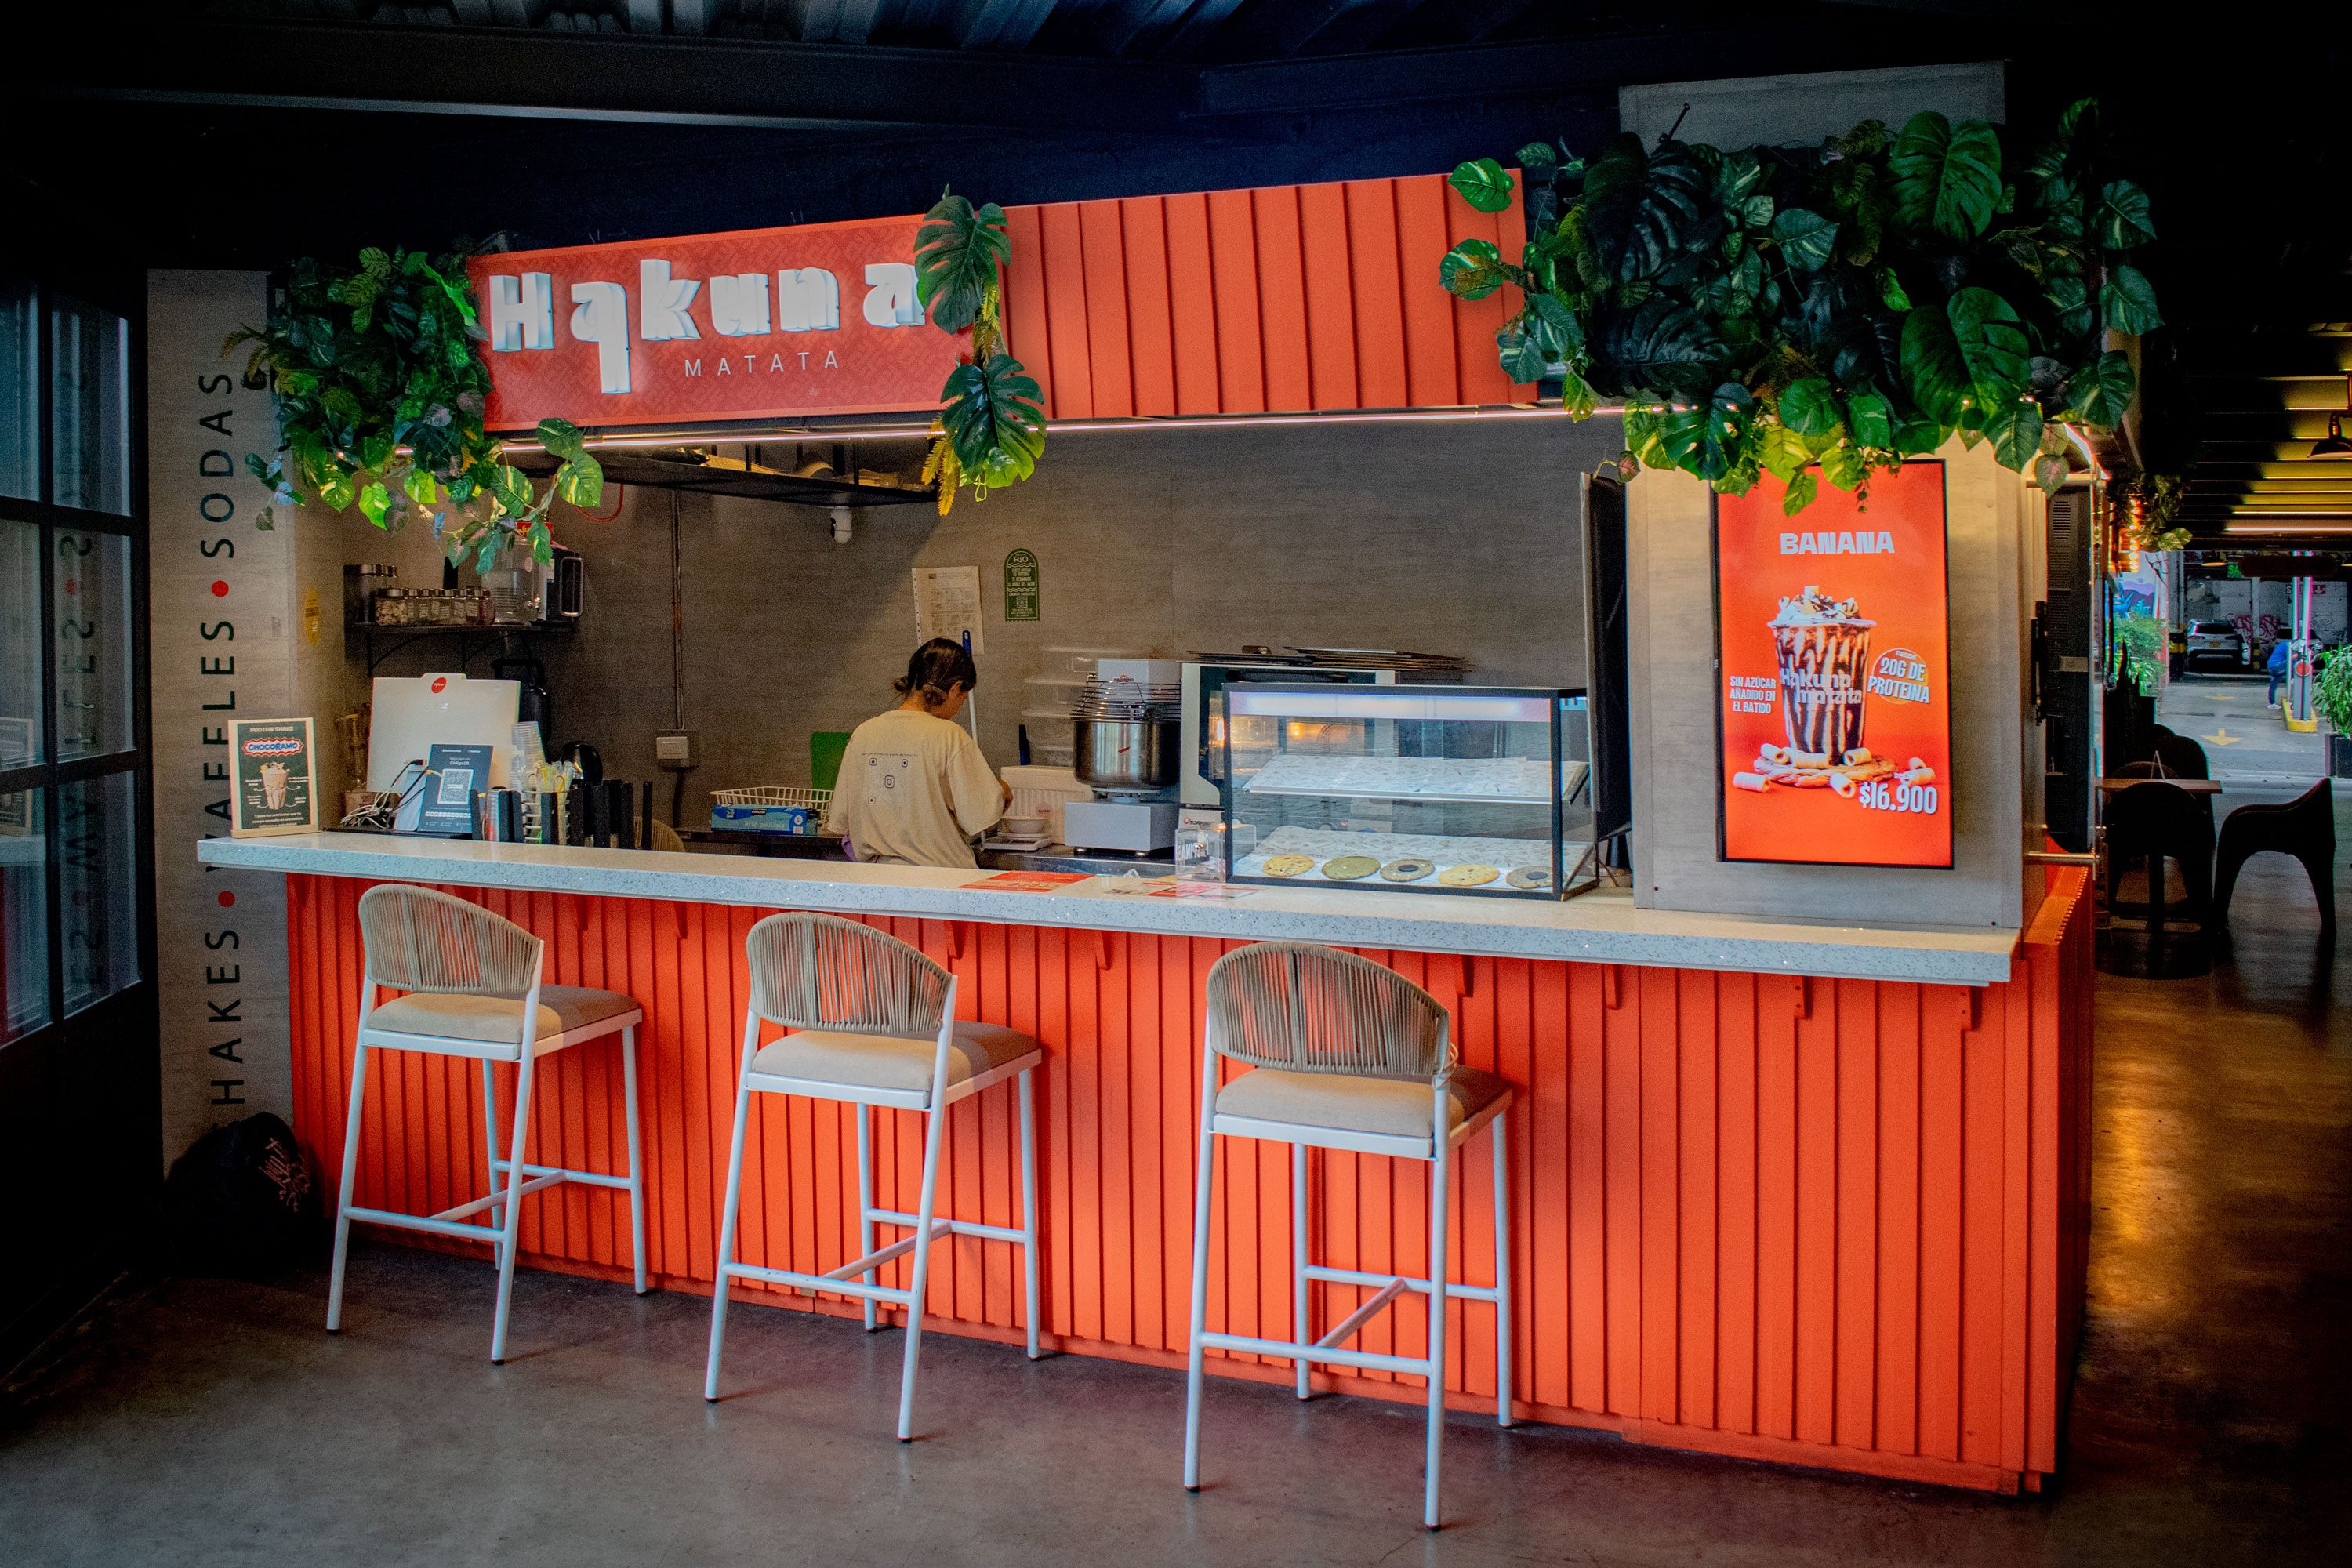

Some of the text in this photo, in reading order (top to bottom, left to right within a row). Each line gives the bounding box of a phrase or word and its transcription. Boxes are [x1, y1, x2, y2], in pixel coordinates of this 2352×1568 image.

[489, 259, 925, 394] Hakuna
[684, 350, 839, 377] MATATA
[198, 375, 234, 558] SODAS
[1780, 532, 1895, 555] BANANA
[1780, 667, 1852, 690] Hakuna
[1879, 657, 1926, 681] 20G DE
[1730, 675, 1777, 689] SIN AZÚCAR
[1730, 688, 1776, 701] AÑADIDO EN
[1797, 687, 1863, 704] matata
[1733, 702, 1771, 714] EL BATIDO
[248, 742, 298, 751] CHOCORAMO
[1859, 781, 1937, 814] $16.900
[205, 930, 245, 1130] HAKES
